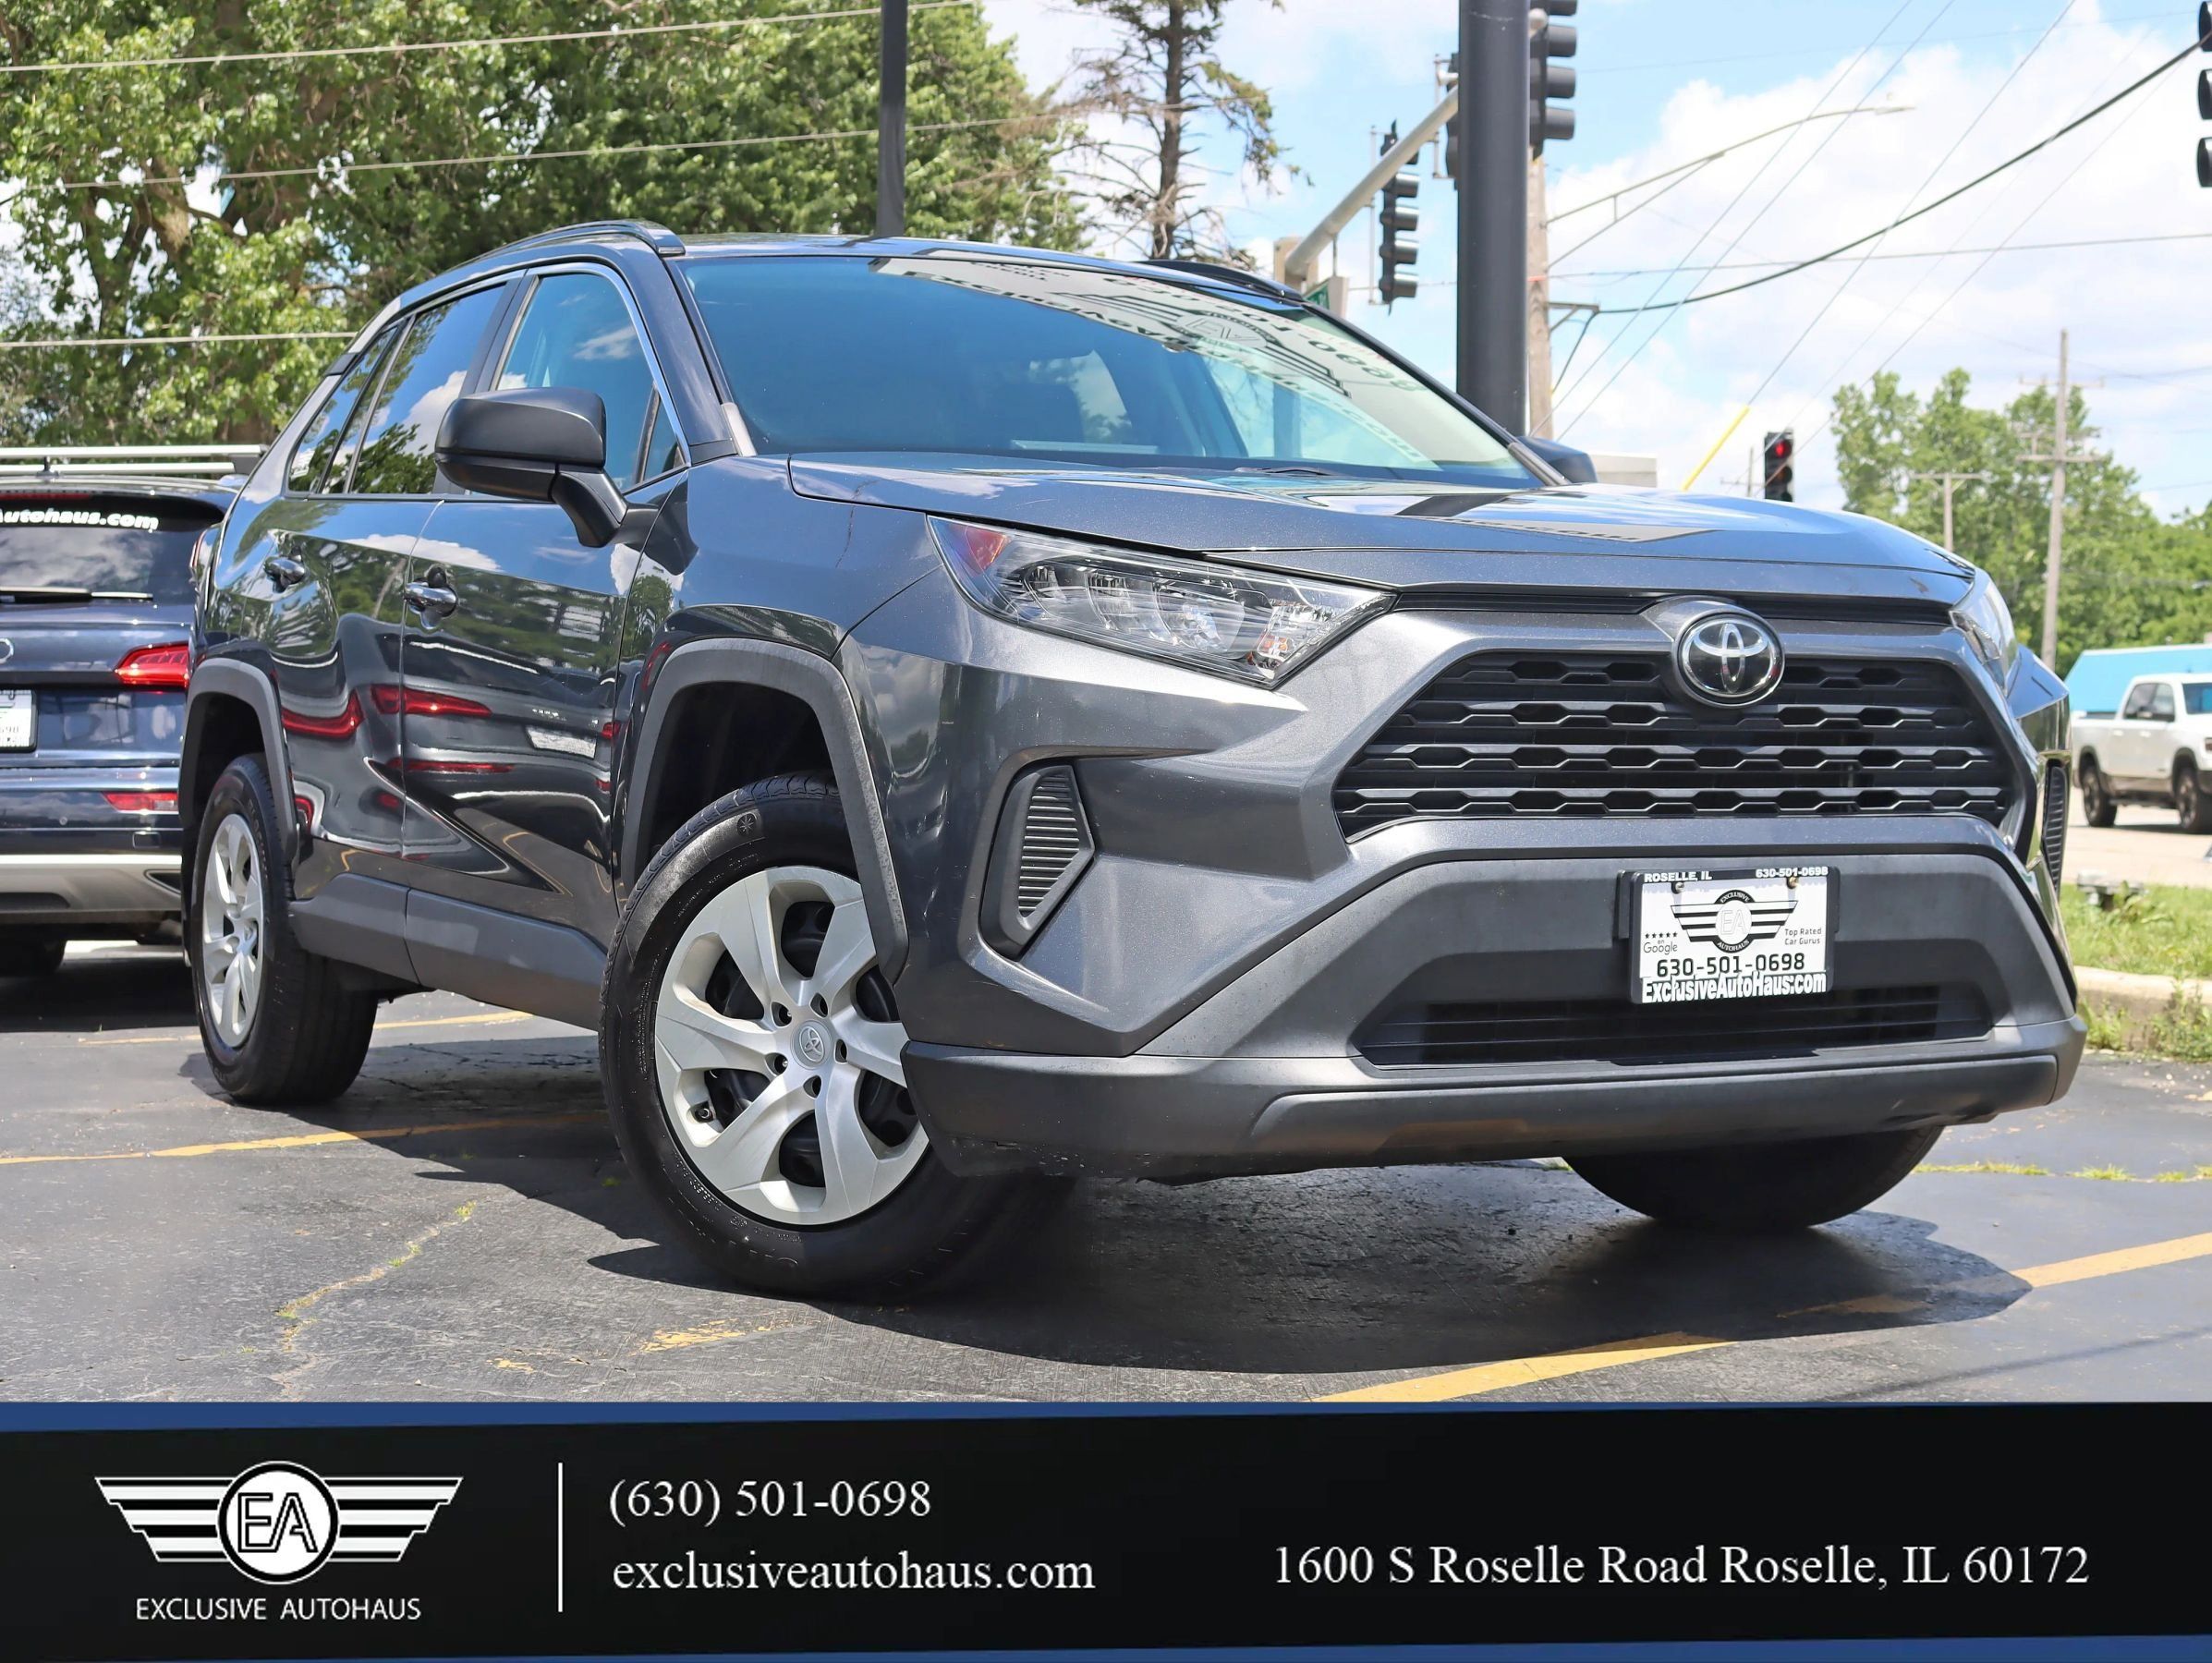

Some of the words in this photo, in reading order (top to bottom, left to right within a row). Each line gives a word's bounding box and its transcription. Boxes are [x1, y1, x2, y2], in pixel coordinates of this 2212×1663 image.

[1645, 871, 1698, 883] ROSELLE,
[1701, 870, 1713, 880] IL
[1720, 892, 1750, 904] EXCLUSIVE
[1784, 928, 1798, 937] Top
[1800, 927, 1822, 935] Rated
[1717, 939, 1750, 952] AUTOHAUS
[1784, 937, 1797, 945] Car
[1799, 936, 1820, 944] Gurus
[1643, 941, 1678, 955] Google
[1657, 953, 1805, 977] 630-501-0698
[1642, 970, 1827, 1003] ExclusiveAutoHaus.com
